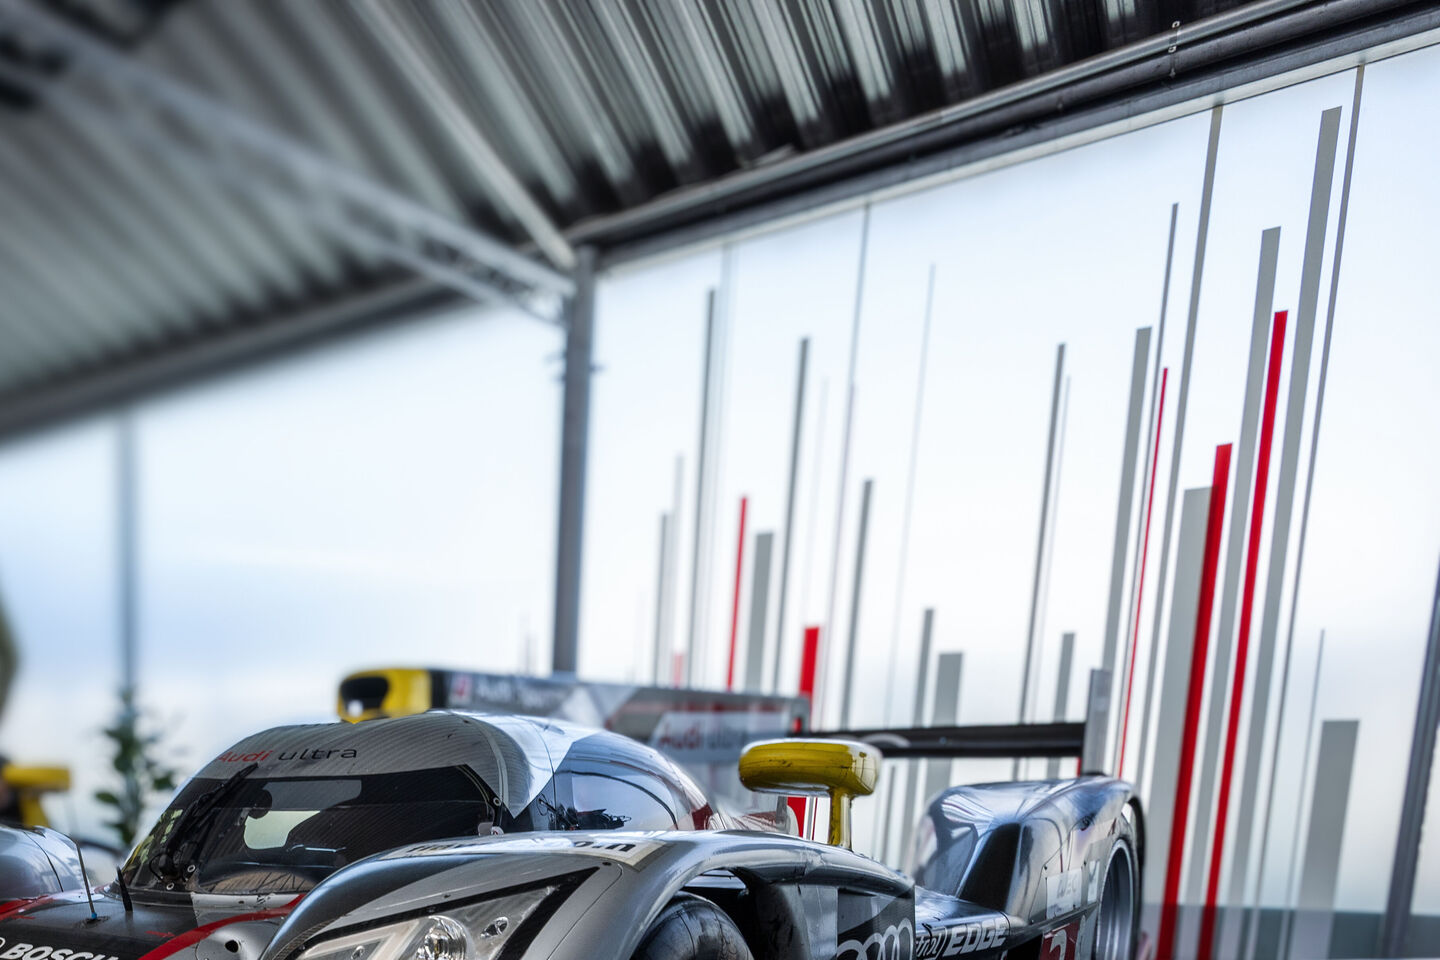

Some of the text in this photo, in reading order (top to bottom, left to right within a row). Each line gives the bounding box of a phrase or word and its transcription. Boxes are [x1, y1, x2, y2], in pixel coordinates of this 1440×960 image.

[217, 748, 358, 763] Audi ultra
[942, 919, 1009, 957] EDGE
